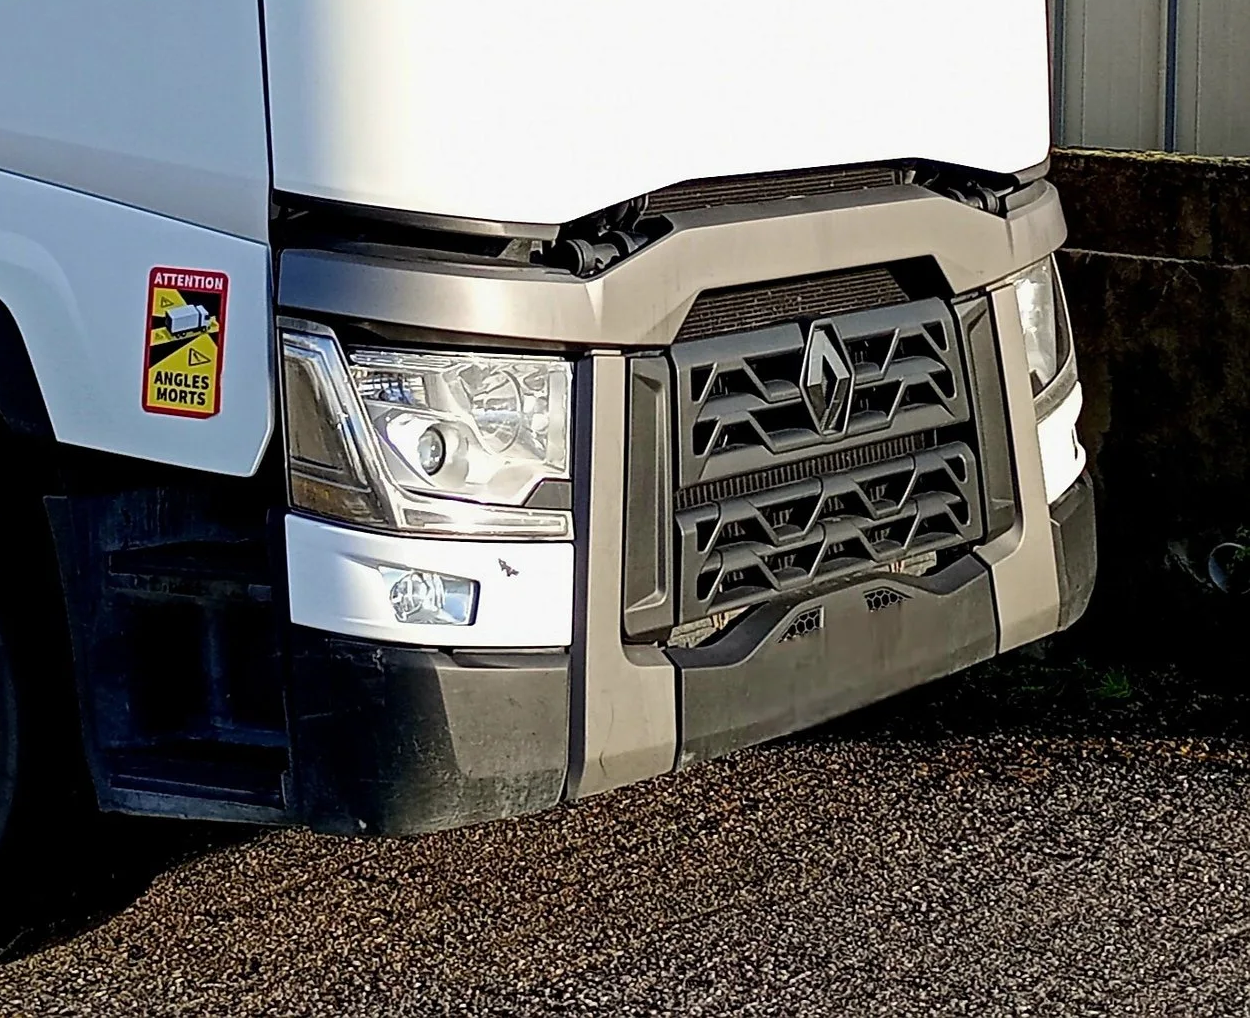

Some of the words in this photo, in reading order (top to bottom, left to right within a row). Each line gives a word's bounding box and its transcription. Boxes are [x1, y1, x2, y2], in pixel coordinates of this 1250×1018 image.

[154, 272, 223, 290] ATTENTION
[154, 371, 209, 390] ANGLES
[156, 387, 206, 406] MORTS
